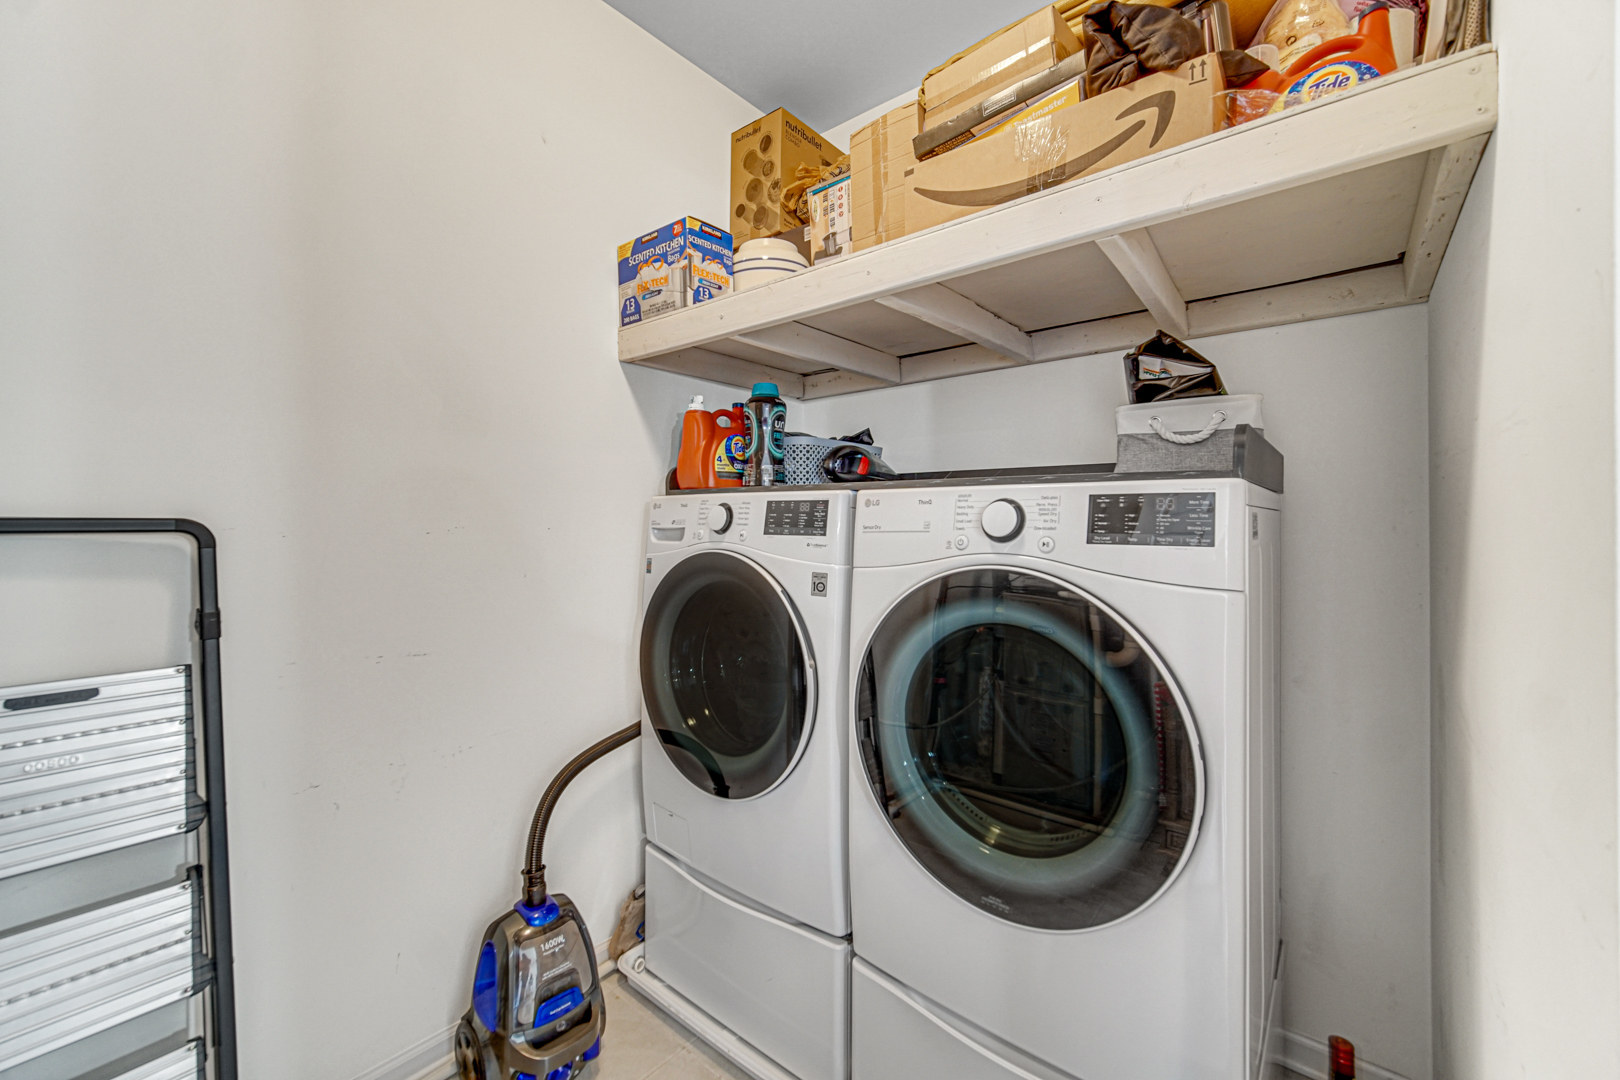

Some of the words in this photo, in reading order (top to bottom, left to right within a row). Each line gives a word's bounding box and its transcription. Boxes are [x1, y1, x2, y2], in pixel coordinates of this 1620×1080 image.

[1308, 73, 1351, 100] Tide
[735, 126, 762, 144] nutribullet
[785, 119, 823, 151] nutribullet
[628, 247, 655, 267] SCENTED
[655, 236, 684, 255] KITCHEN
[688, 234, 712, 250] SCENTED
[712, 243, 733, 257] KITCHEN
[667, 252, 680, 264] Bags
[698, 287, 709, 299] 13
[625, 298, 635, 311] 13
[716, 455, 722, 463] 4
